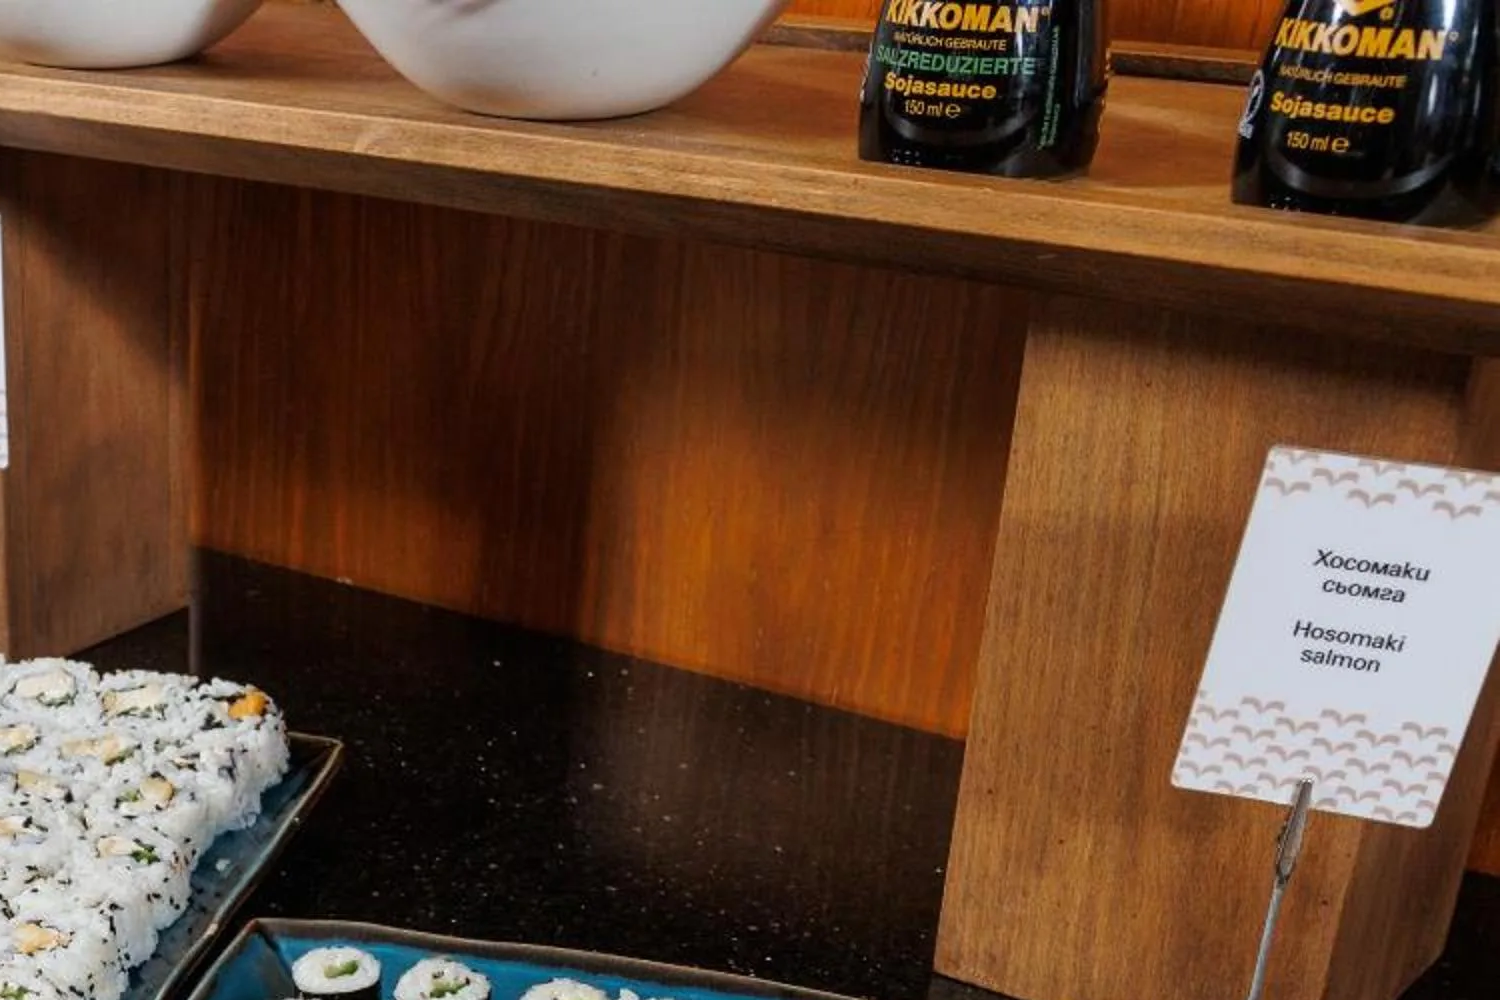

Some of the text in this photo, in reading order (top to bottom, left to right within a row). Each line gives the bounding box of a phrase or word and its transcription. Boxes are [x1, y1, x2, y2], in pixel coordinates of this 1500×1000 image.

[886, 0, 1040, 33] KIKKOMAN
[1275, 17, 1446, 61] KIKKOMAN
[875, 45, 1037, 76] SALZREDUZIERTE
[884, 72, 997, 99] Sojasauce
[904, 100, 925, 115] 150
[927, 103, 943, 117] ml
[1270, 91, 1395, 124] Sojasauce
[1286, 131, 1308, 148] 150
[1311, 136, 1329, 151] ml
[1293, 619, 1408, 653] Hosomaki
[1299, 648, 1381, 673] salmon
